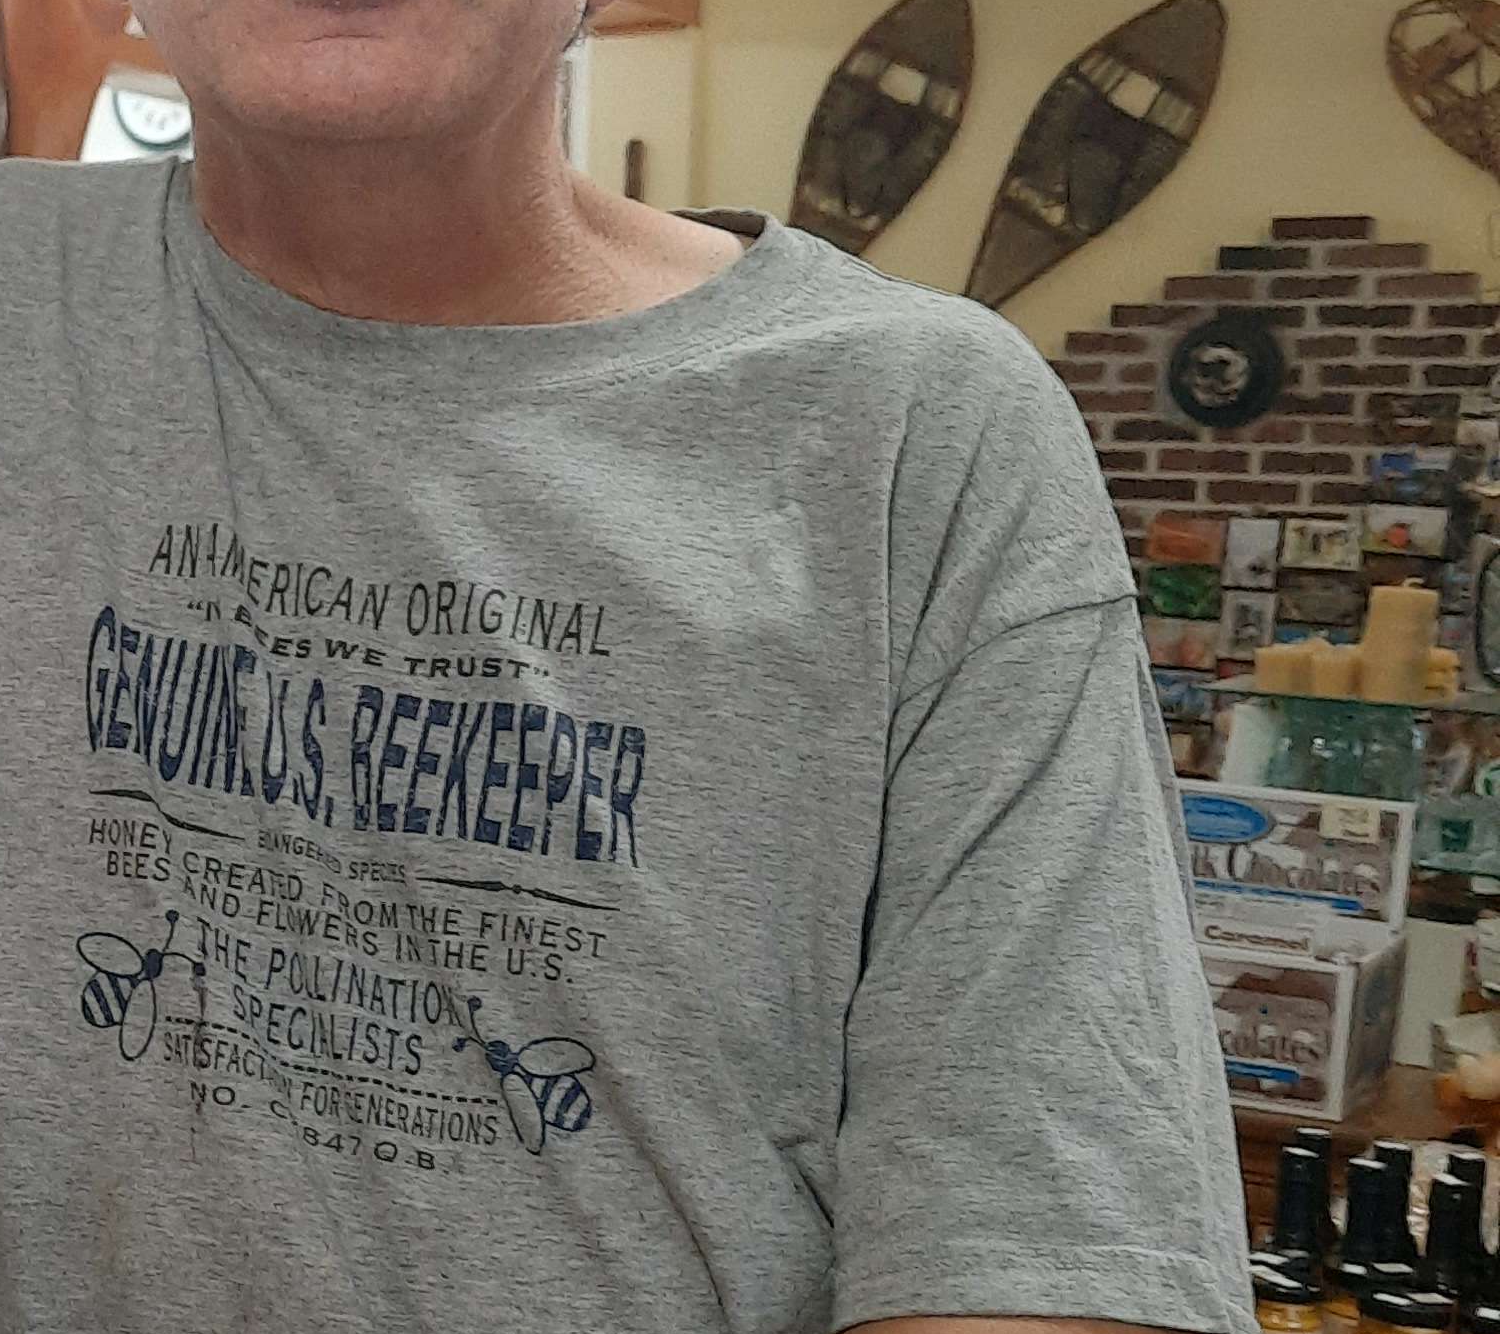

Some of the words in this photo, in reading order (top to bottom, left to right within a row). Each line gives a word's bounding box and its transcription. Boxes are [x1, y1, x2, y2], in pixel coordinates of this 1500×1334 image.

[149, 523, 200, 579] AN
[406, 580, 610, 657] ORIGINAL
[325, 638, 387, 667] WE
[261, 670, 334, 828] U.S.
[350, 683, 647, 868] BEEKEEPER
[89, 818, 173, 855] HONEY
[321, 881, 399, 929] FROM
[405, 903, 463, 936] THE
[479, 910, 608, 958] FINEST
[106, 850, 172, 881] BEES
[183, 875, 241, 917] AND
[427, 938, 490, 971] THE
[506, 947, 574, 984] U.S.
[197, 917, 251, 984] THE
